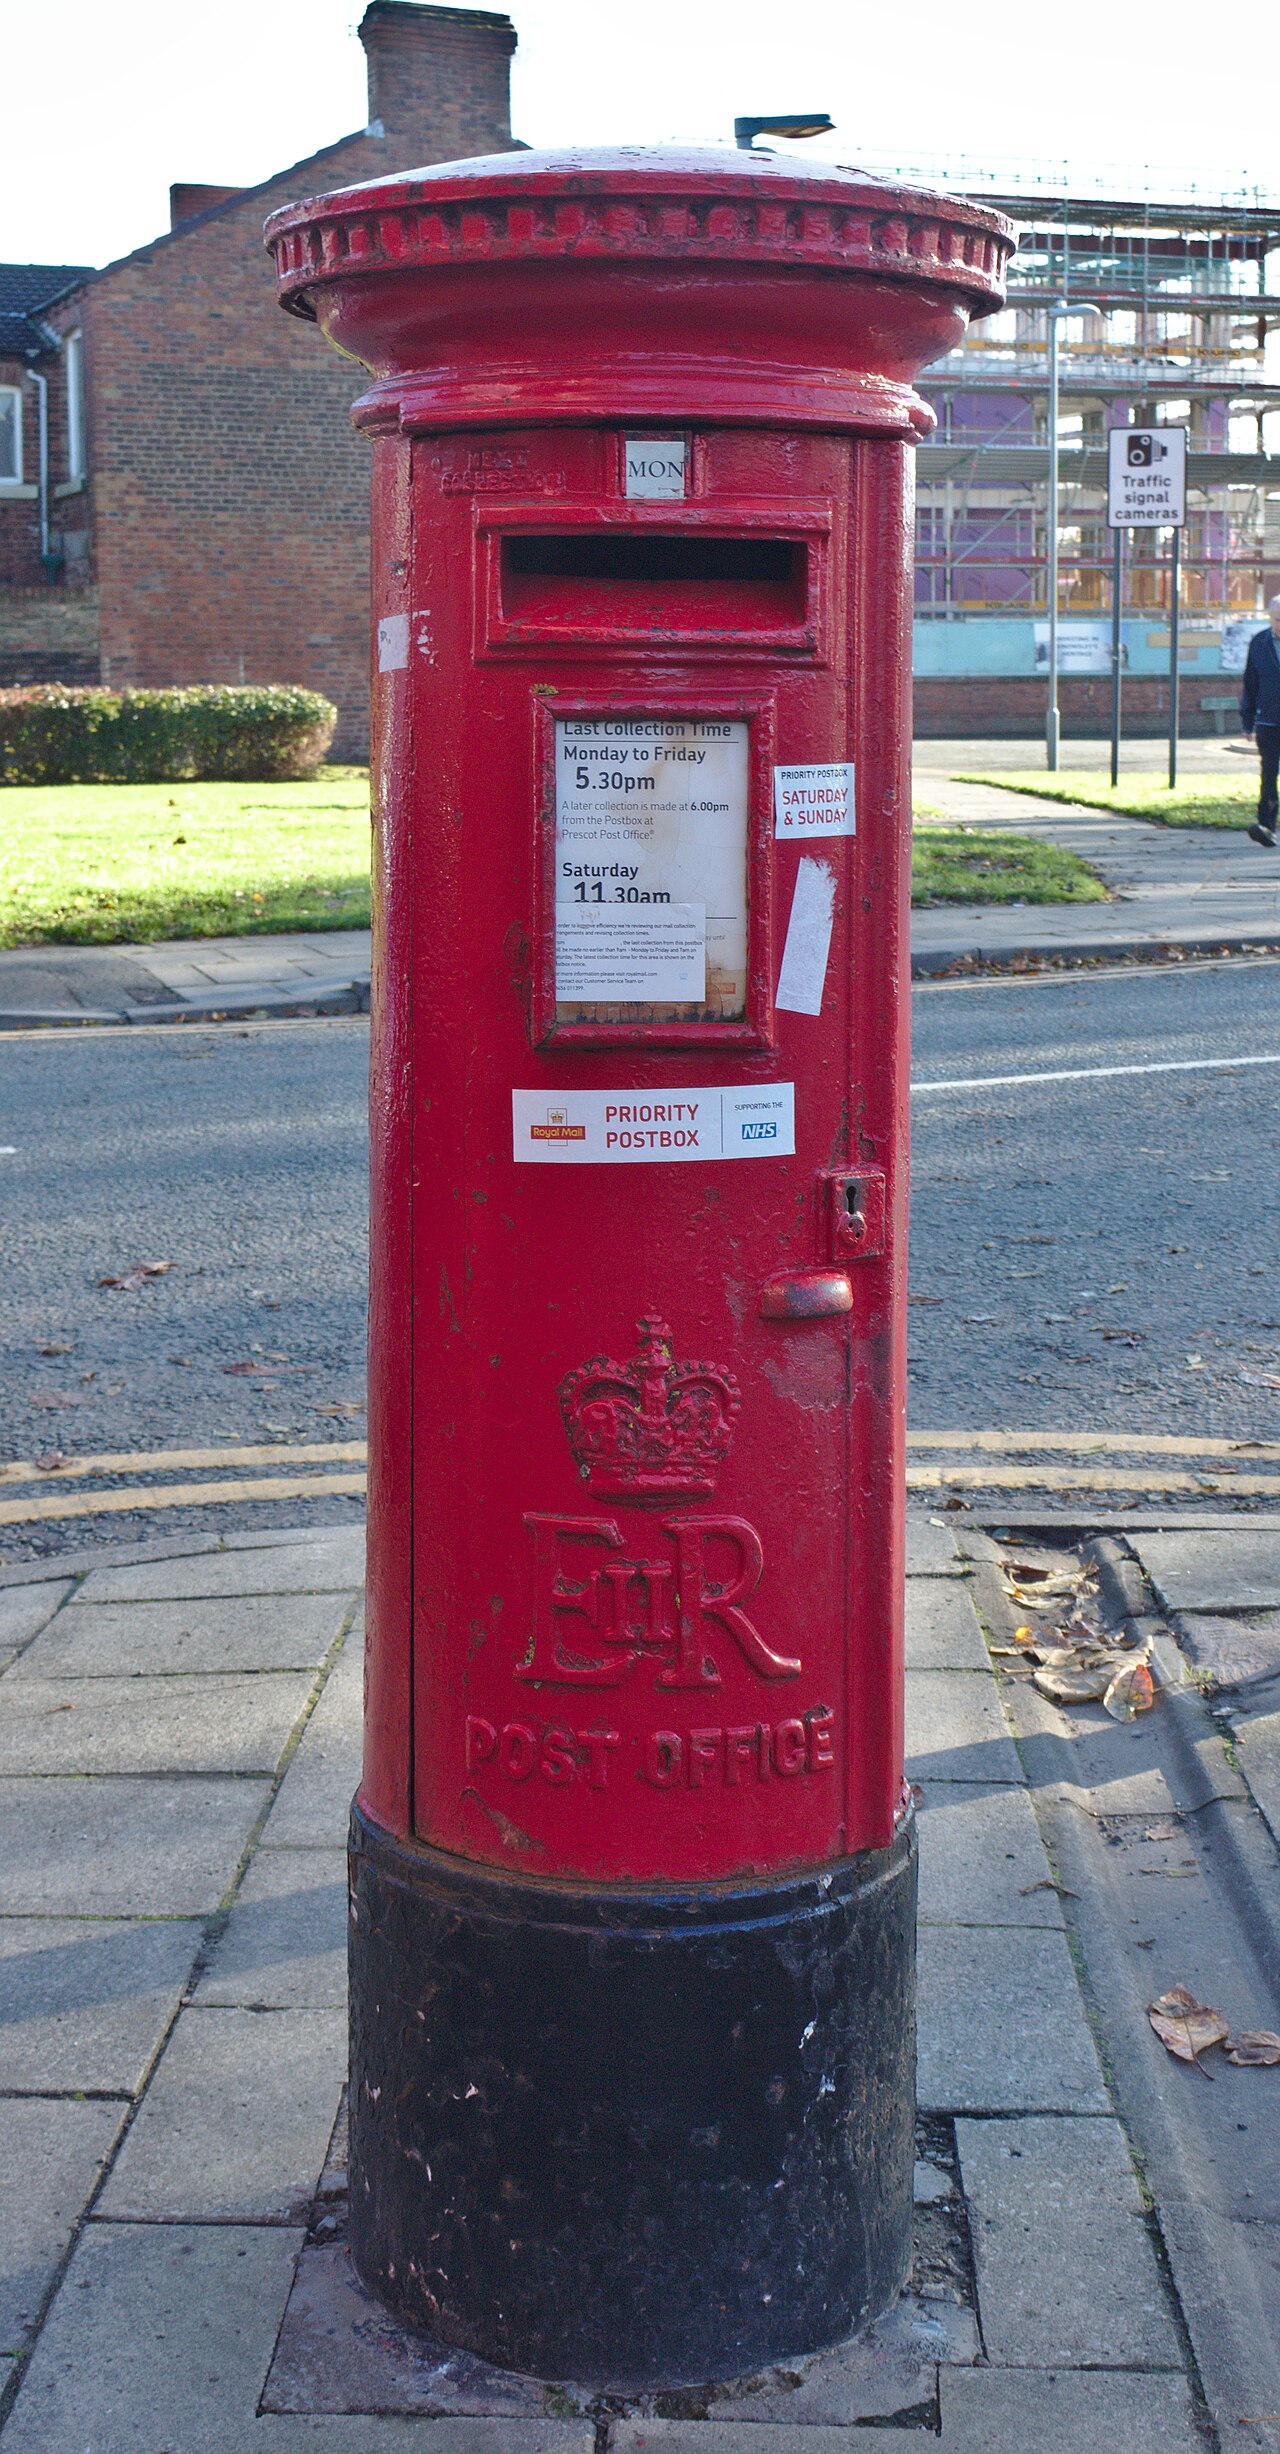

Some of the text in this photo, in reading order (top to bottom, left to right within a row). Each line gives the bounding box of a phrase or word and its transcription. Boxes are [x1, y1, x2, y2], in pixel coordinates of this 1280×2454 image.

[627, 460, 685, 478] MON
[1122, 475, 1172, 488] Traffic
[1124, 489, 1170, 504] signal
[1114, 508, 1179, 520] cameras
[563, 722, 732, 737] Last Collection Time
[563, 746, 706, 764] Monday to Friday
[575, 766, 655, 793] 5.30pm
[781, 769, 848, 779] PRIORITY POSTBOX
[782, 788, 848, 805] SATURDAY
[562, 801, 729, 813] A later collection is made at 6.00pm
[562, 815, 654, 825] from the Postbox at
[783, 808, 848, 826] & SUNDAY
[562, 829, 598, 840] Prescot
[600, 829, 621, 840] Post
[562, 862, 639, 880] Saturday
[574, 881, 671, 903] 11.30am
[605, 1104, 699, 1122] PRIORITY
[734, 1101, 783, 1111] SUPPORTING THE
[533, 1126, 583, 1139] Royal Mail
[606, 1130, 700, 1148] POSTBOX
[742, 1122, 777, 1139] NHS
[466, 1705, 835, 1789] POST OFFICE
